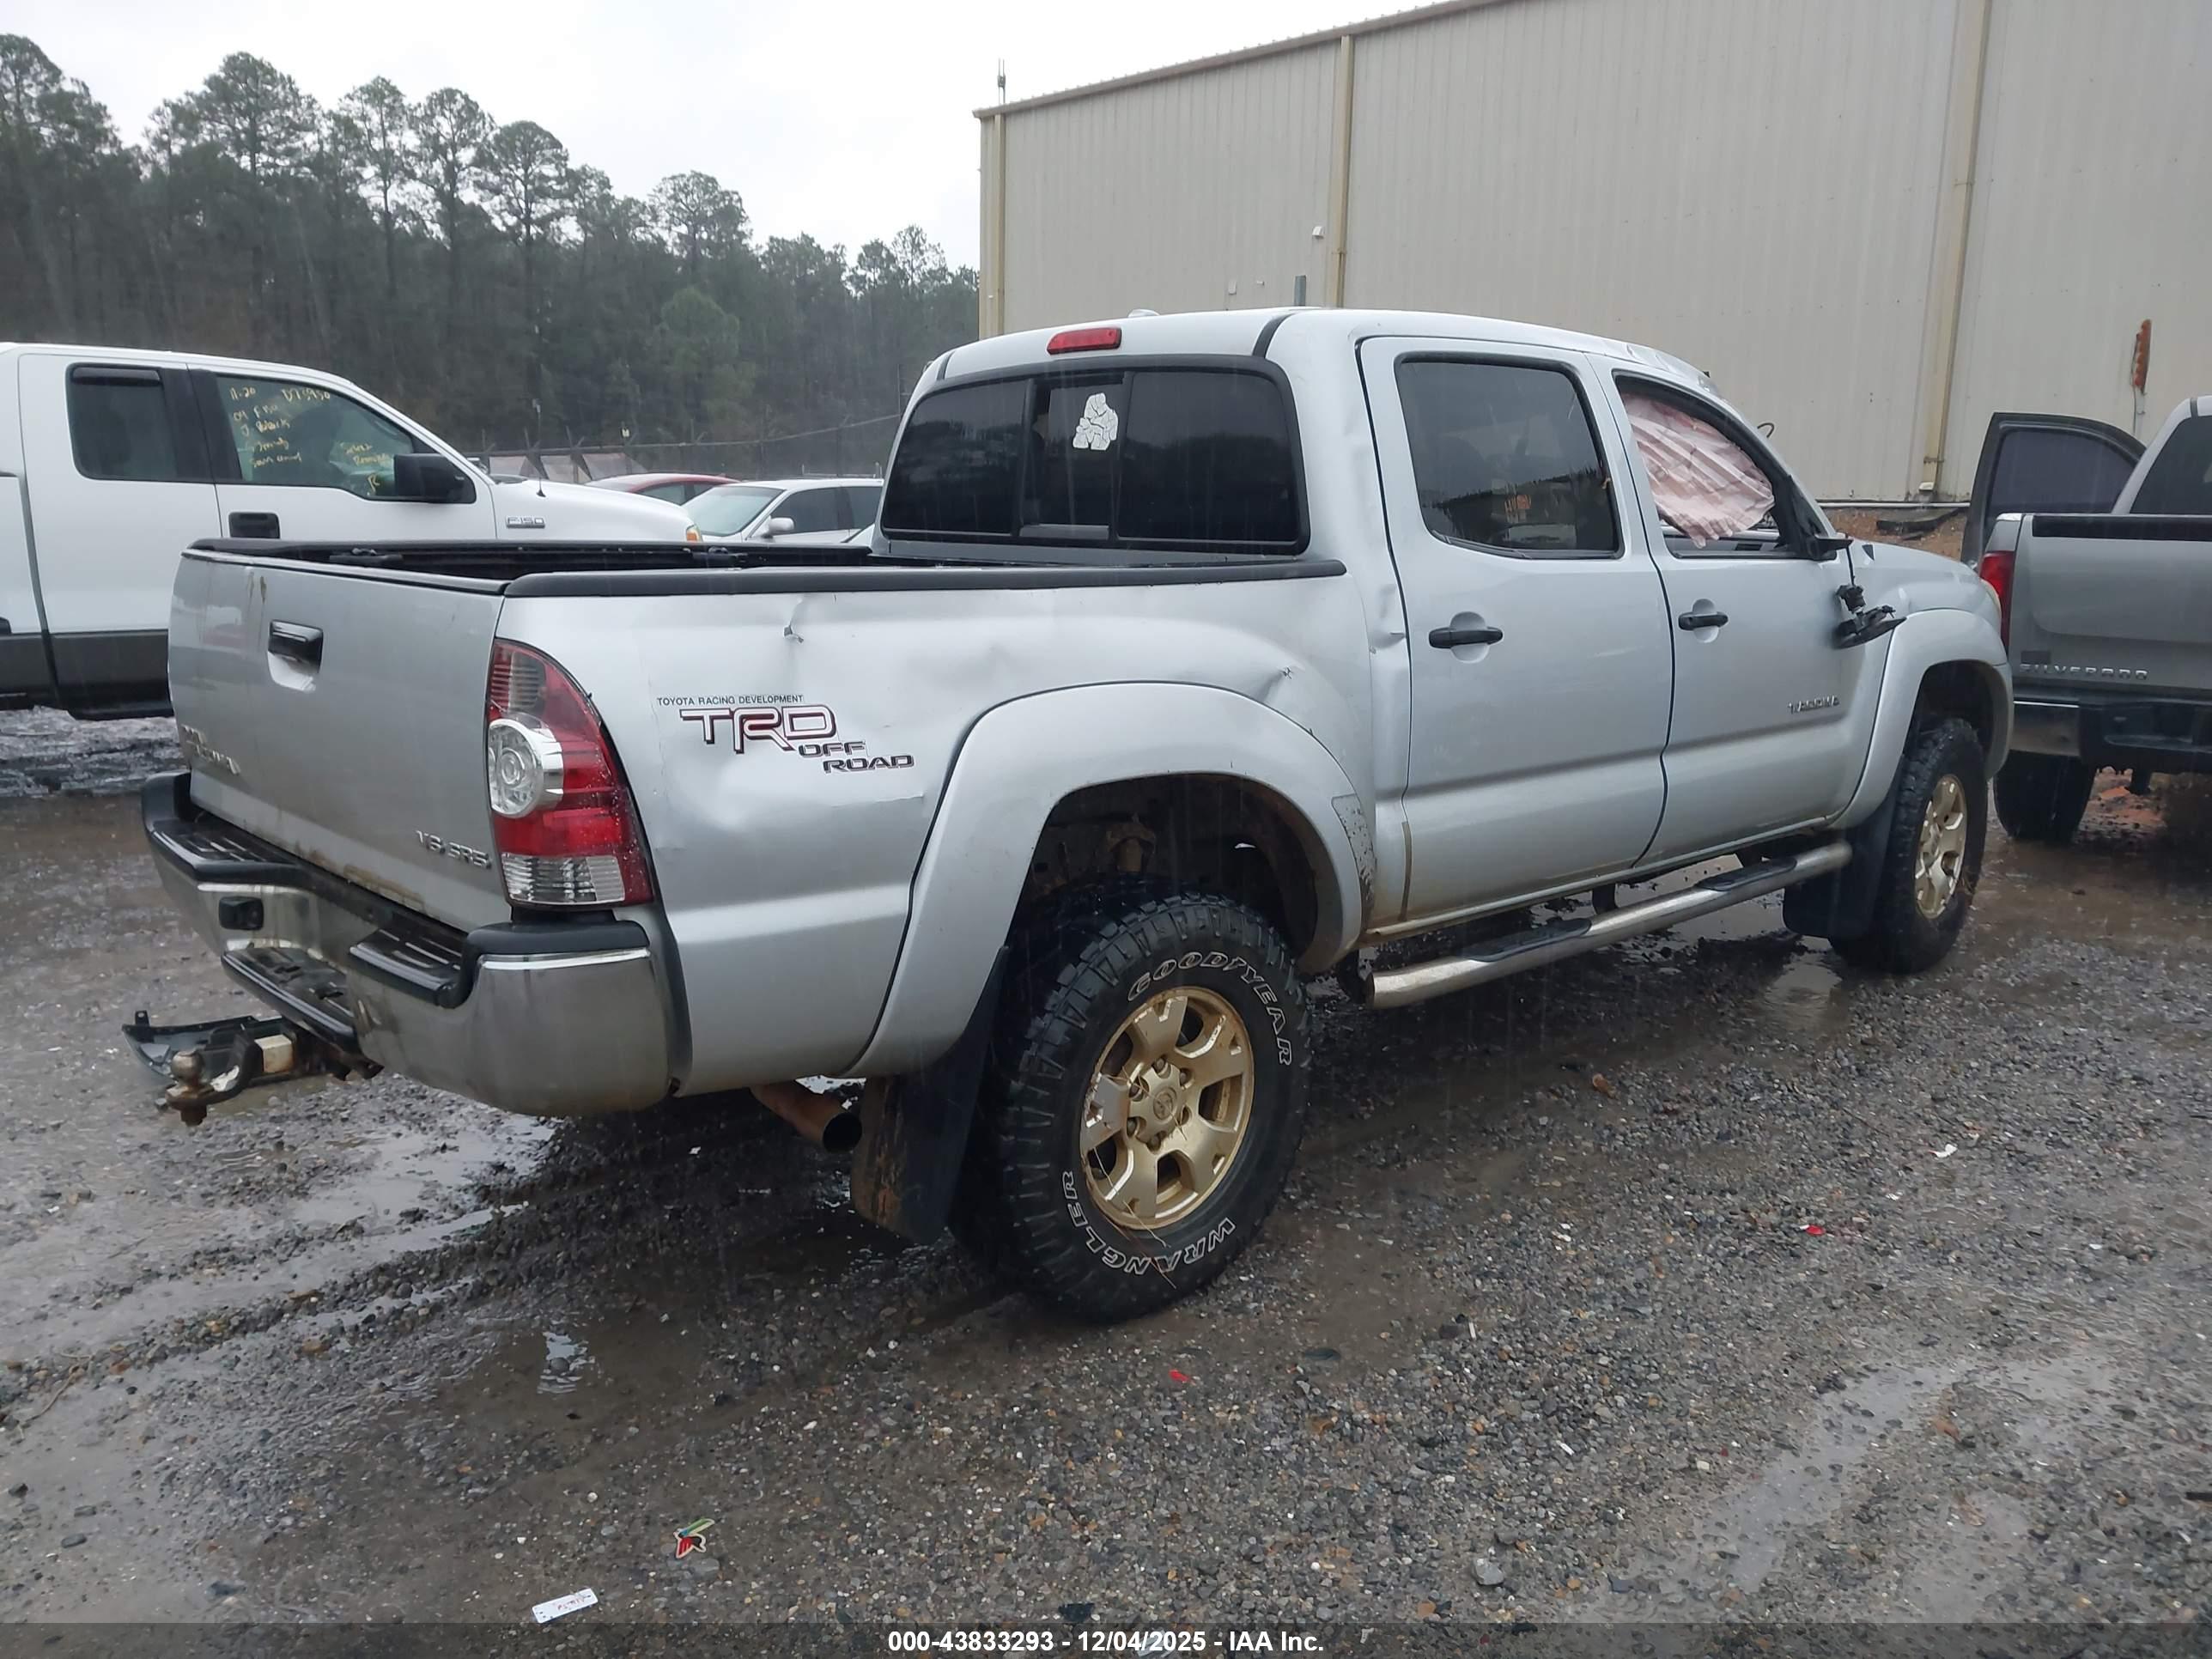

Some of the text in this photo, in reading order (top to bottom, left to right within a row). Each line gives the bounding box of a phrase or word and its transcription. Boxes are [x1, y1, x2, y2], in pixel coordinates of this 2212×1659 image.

[2020, 663, 2148, 680] SILVERADO
[657, 695, 804, 706] TOYOTA RACING DEVELOPMENT
[679, 704, 836, 754] TRD
[798, 740, 866, 757] OFF
[823, 755, 915, 774] ROAD
[1128, 951, 1292, 1066] GOODYEAR
[1062, 1170, 1236, 1275] WRANGLER
